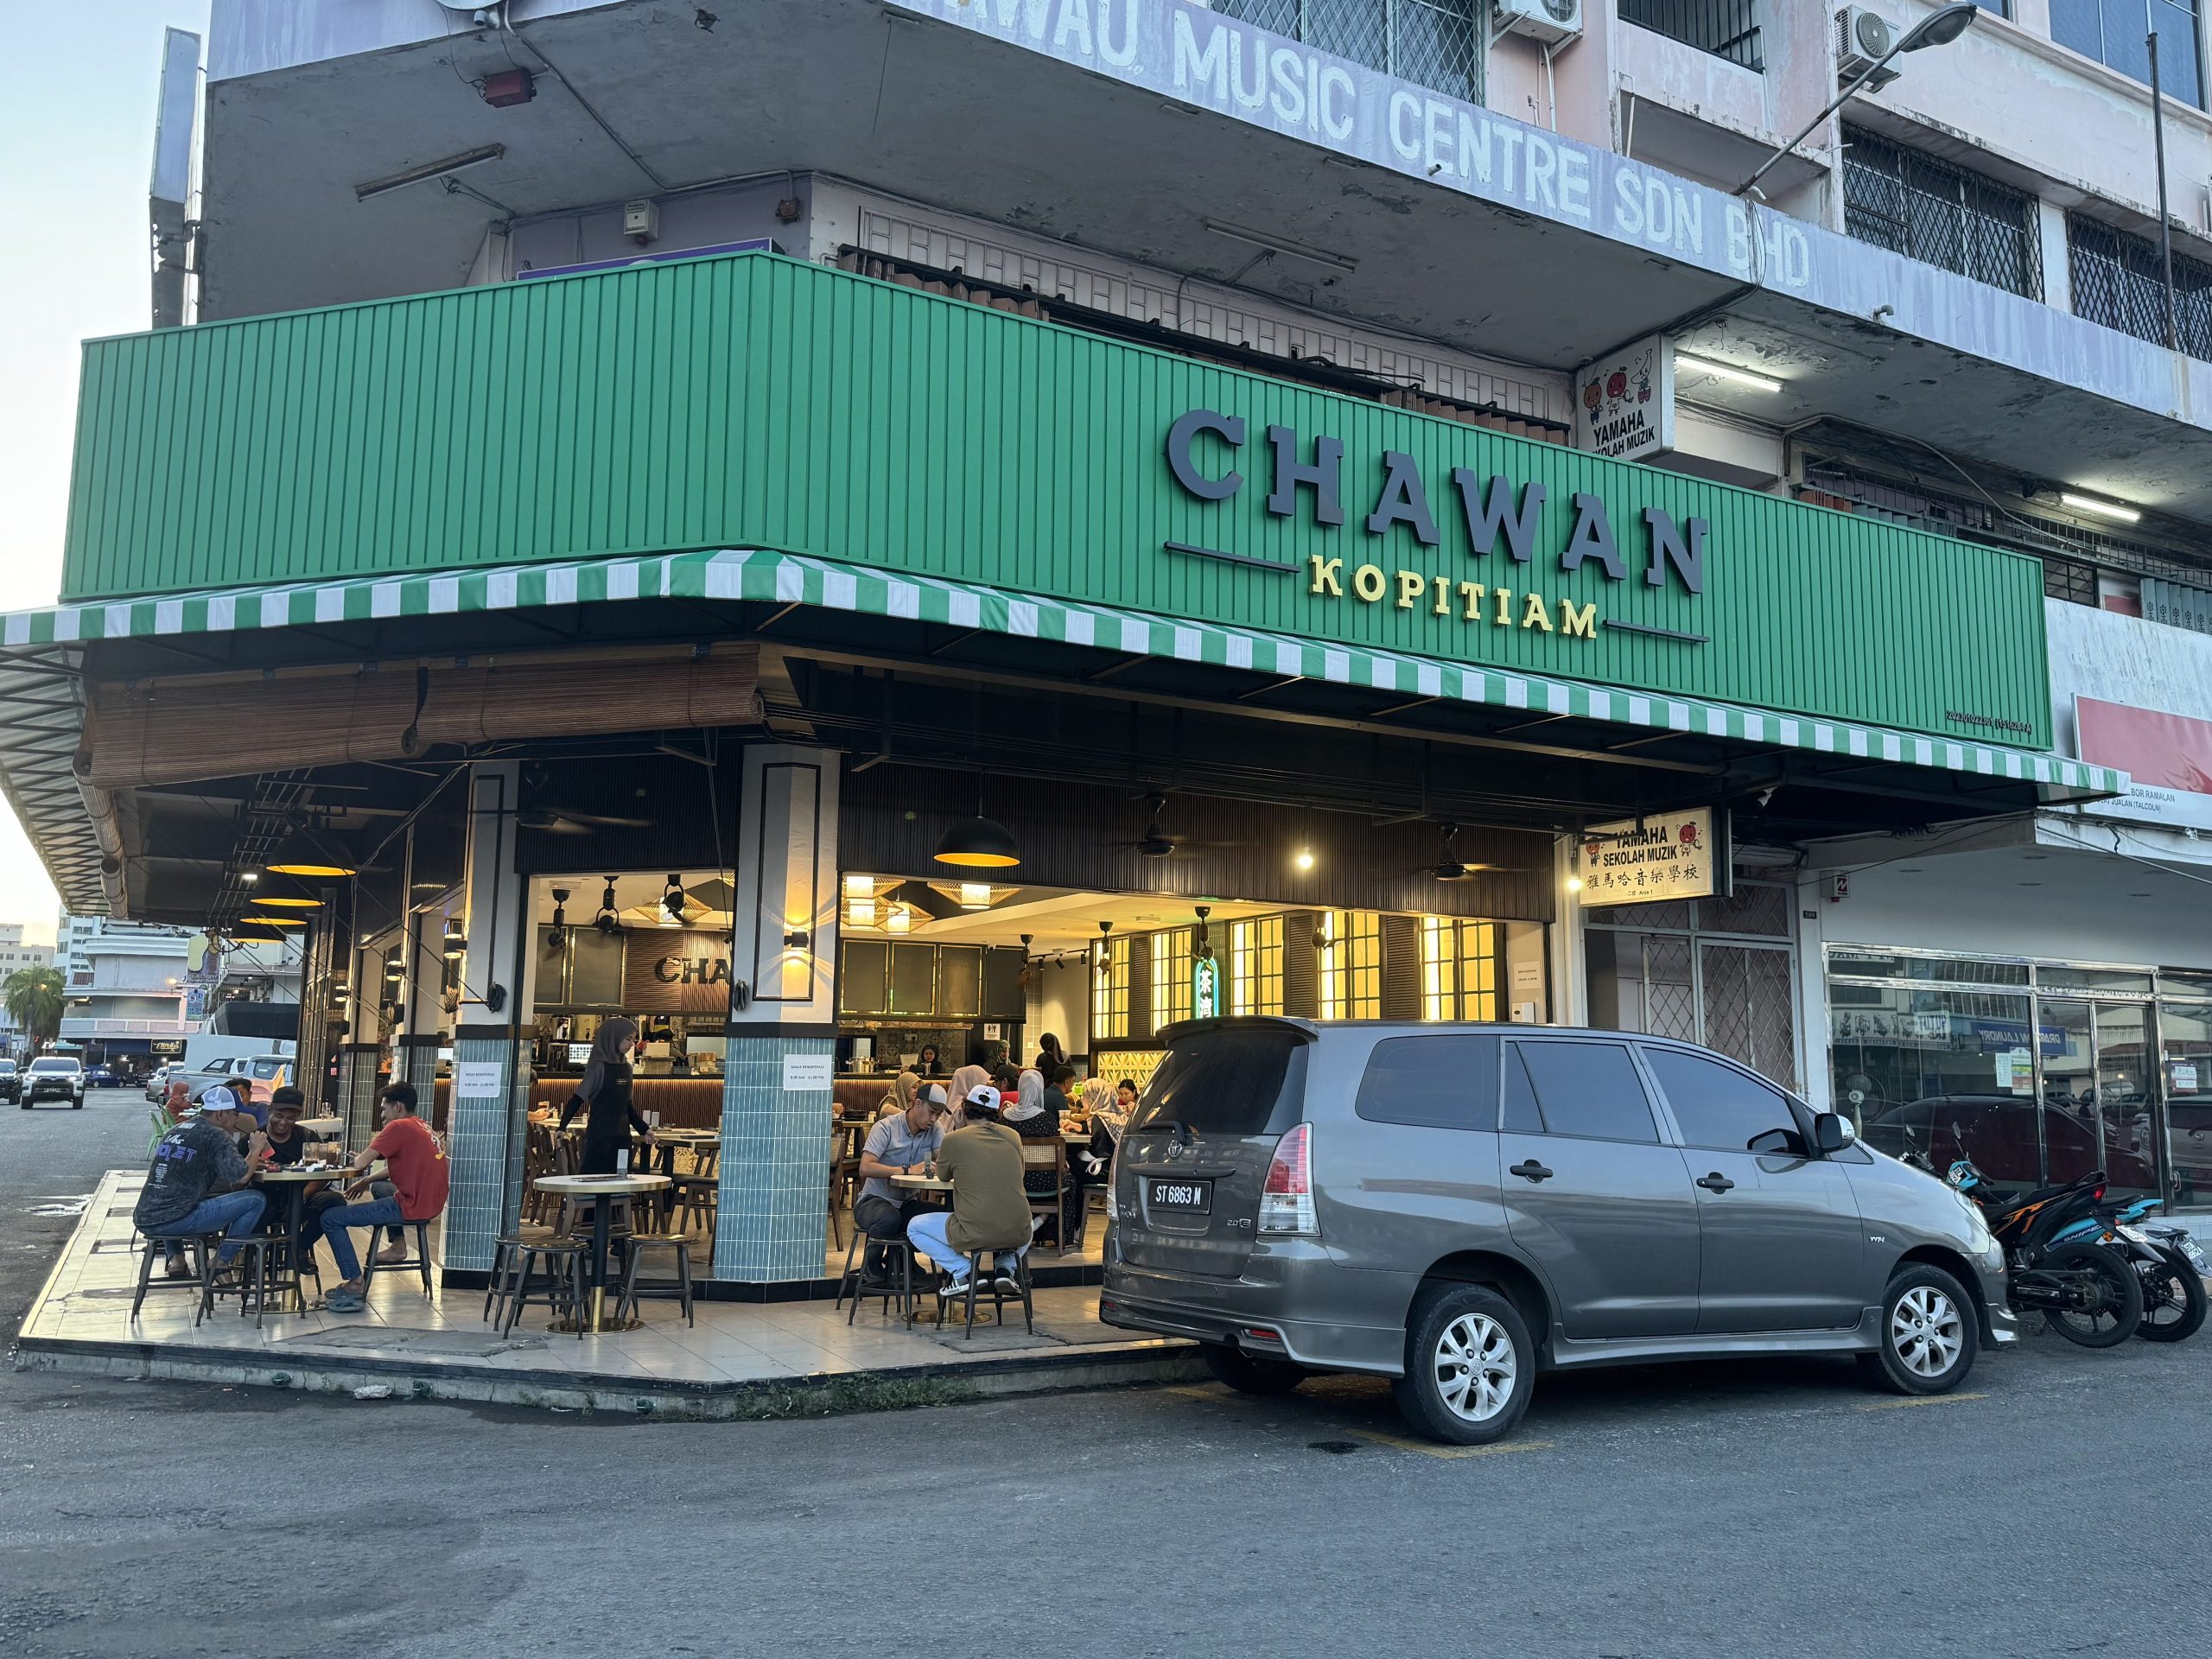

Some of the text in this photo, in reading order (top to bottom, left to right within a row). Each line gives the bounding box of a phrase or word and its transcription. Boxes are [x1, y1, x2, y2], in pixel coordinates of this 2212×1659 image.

[1173, 9, 1356, 140] MUSIC
[1389, 90, 1592, 220] CENTRE
[1614, 168, 1704, 255] SDN
[1727, 203, 1809, 288] BHD
[1593, 410, 1645, 447] YAMAHA
[1626, 426, 1655, 451] MUZIK
[1167, 408, 1707, 594] CHAWAN
[1309, 554, 1597, 639] KOPITIAM
[2145, 790, 2176, 803] RAMALAN
[1614, 826, 1668, 849] YAMAHA
[1603, 845, 1678, 868] SEKOLAH MUZIK
[1155, 1185, 1202, 1205] ST 6863 M
